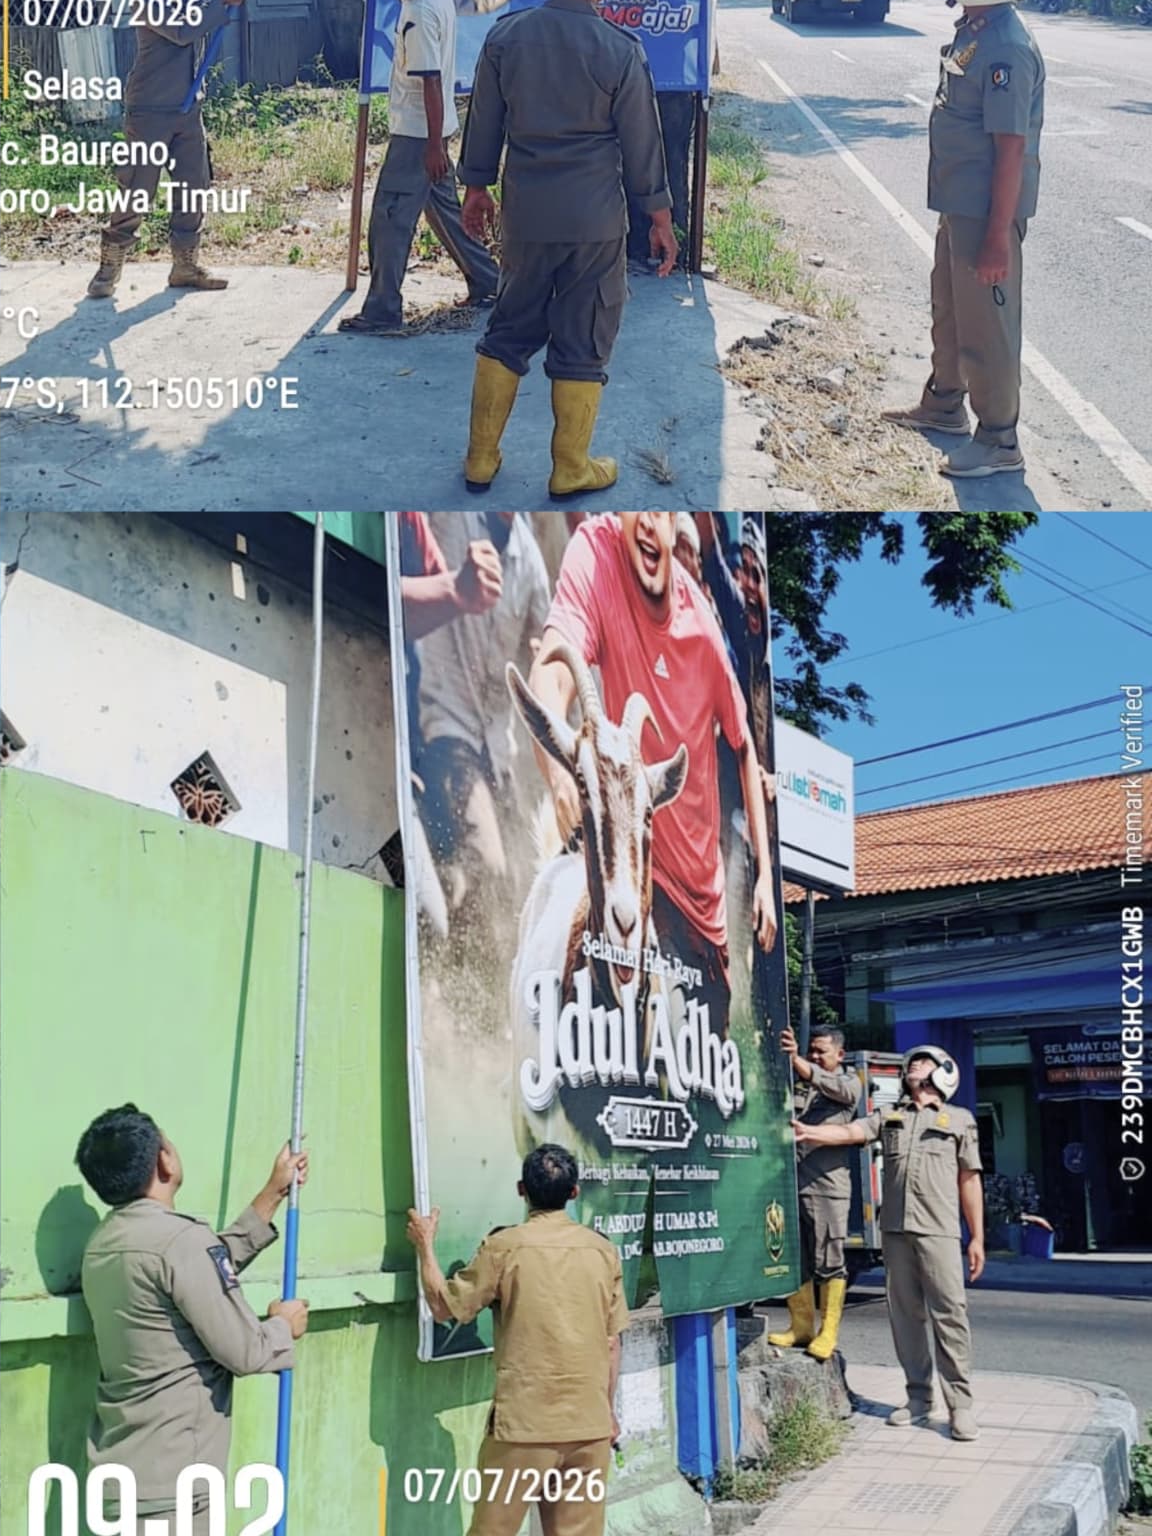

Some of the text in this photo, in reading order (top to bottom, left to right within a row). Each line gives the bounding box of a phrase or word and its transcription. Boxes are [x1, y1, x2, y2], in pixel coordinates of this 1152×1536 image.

[643, 947, 672, 975] Hari
[674, 958, 703, 990] Raya
[643, 992, 745, 1118] Adha
[1043, 1041, 1100, 1055] SELAMAT
[1044, 1053, 1086, 1065] CALON
[625, 1110, 678, 1137] 1447 H
[665, 1211, 698, 1230] UMAR
